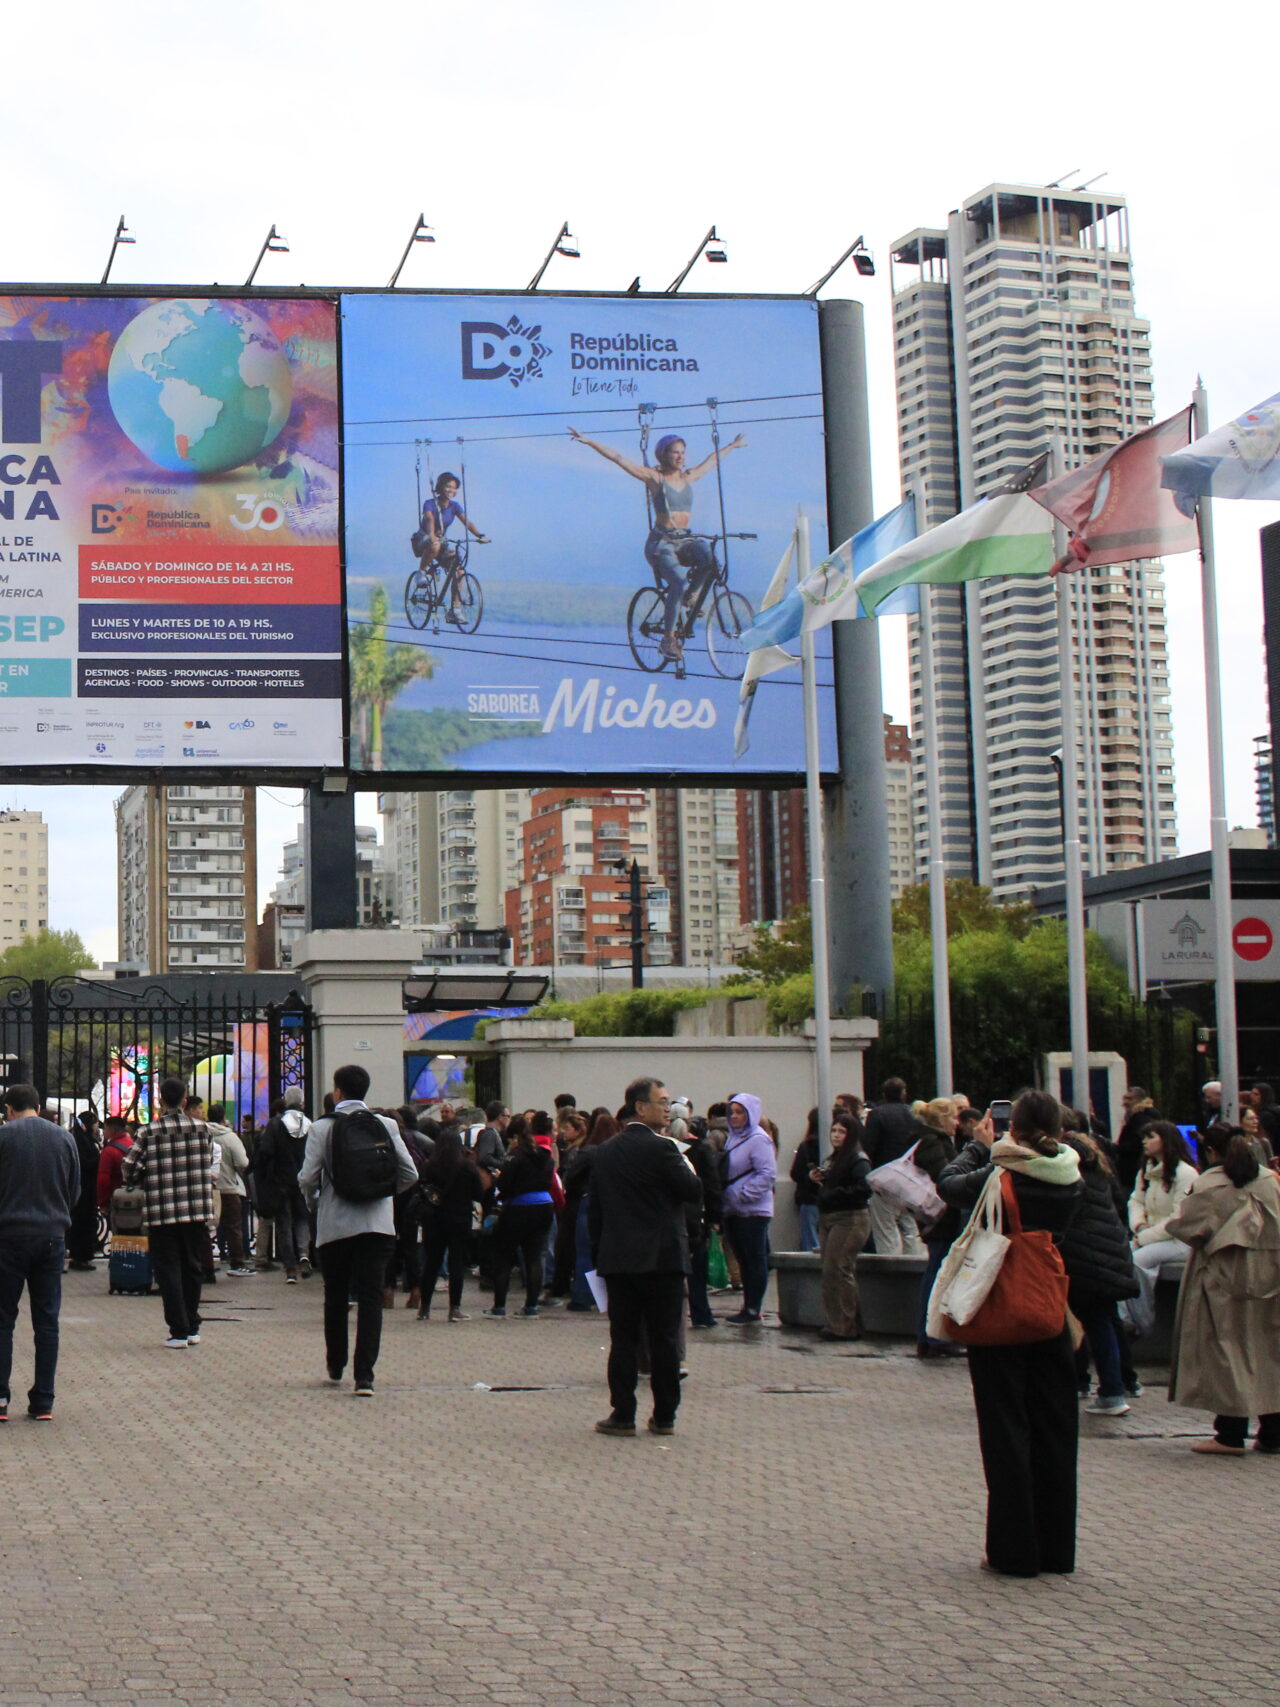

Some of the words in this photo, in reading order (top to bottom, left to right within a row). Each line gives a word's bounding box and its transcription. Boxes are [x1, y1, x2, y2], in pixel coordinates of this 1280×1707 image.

[571, 333, 678, 353] República
[571, 354, 699, 372] Dominicana
[586, 377, 616, 394] Tiene
[147, 510, 201, 519] República
[228, 493, 285, 531] 30
[147, 519, 210, 529] Dominicana
[14, 536, 34, 547] DE
[9, 552, 62, 563] LATINA
[91, 560, 141, 571] SÁBADO
[144, 562, 152, 571] Y
[155, 562, 214, 571] DOMINGO
[217, 562, 233, 571] DE
[235, 562, 248, 571] 14
[251, 562, 259, 571] A
[261, 562, 272, 571] 21
[275, 562, 295, 571] HS.
[91, 574, 135, 583] PÚBLICO
[147, 575, 230, 584] PROFESIONALES
[233, 576, 252, 584] DEL
[254, 576, 293, 584] SECTOR
[91, 619, 129, 628] LUNES
[132, 619, 140, 628] Y
[143, 619, 191, 628] MARTES
[194, 619, 210, 628] DE
[212, 619, 225, 628] 10
[228, 619, 236, 628] A
[238, 619, 251, 628] 19
[254, 619, 273, 629] HS.
[91, 632, 145, 640] EXCLUSIVO
[147, 632, 226, 640] PROFESIONALES
[229, 632, 248, 640] DEL
[250, 632, 294, 640] TURISMO
[8, 665, 29, 677] EN
[85, 669, 130, 677] DESTINOS
[136, 667, 167, 677] PAÍSES
[174, 669, 229, 677] PROVINCIAS
[236, 669, 300, 677] TRANSPORTES
[85, 679, 130, 687] AGENCIAS
[137, 679, 164, 687] FOOD
[170, 679, 205, 687] SHOWS
[212, 679, 257, 687] OUTDOOR
[264, 679, 305, 687] HOTELES
[468, 693, 540, 713] SABOREA
[541, 678, 716, 734] Miches
[196, 721, 211, 729] BA
